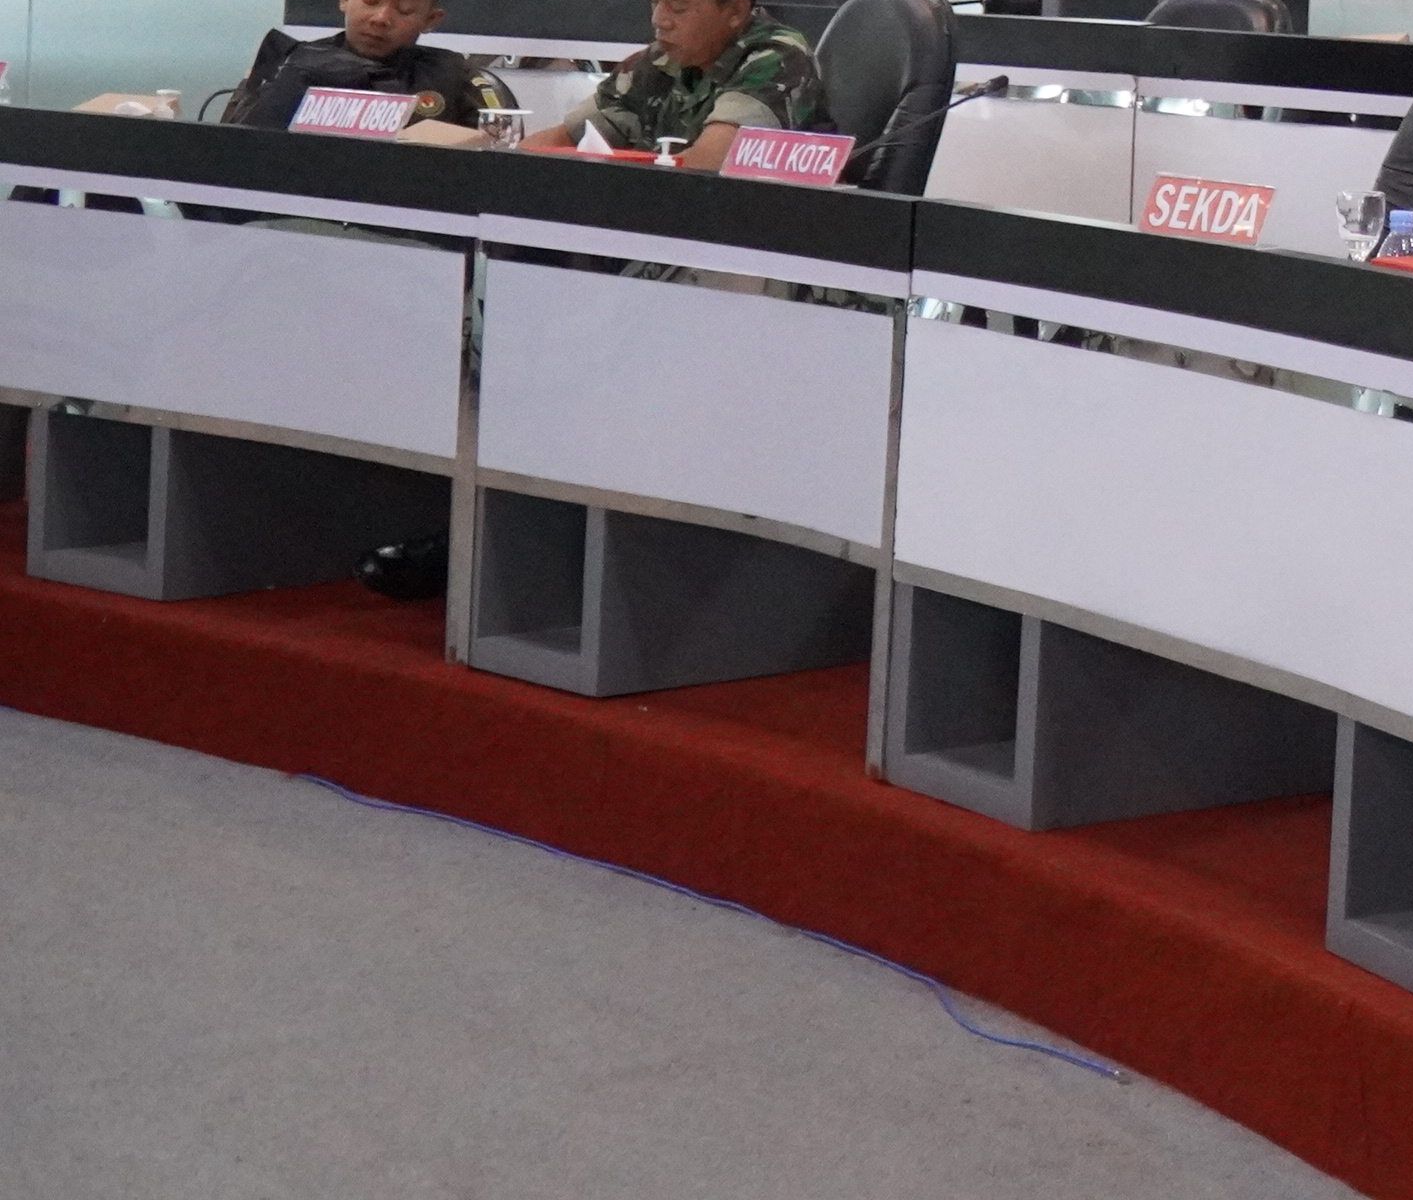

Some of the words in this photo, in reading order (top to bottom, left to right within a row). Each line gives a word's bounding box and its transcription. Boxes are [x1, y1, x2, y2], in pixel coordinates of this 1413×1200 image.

[295, 94, 367, 129] DANDIM
[735, 138, 788, 170] WALI
[785, 142, 838, 176] KOTA
[1148, 183, 1260, 238] SEKDA
